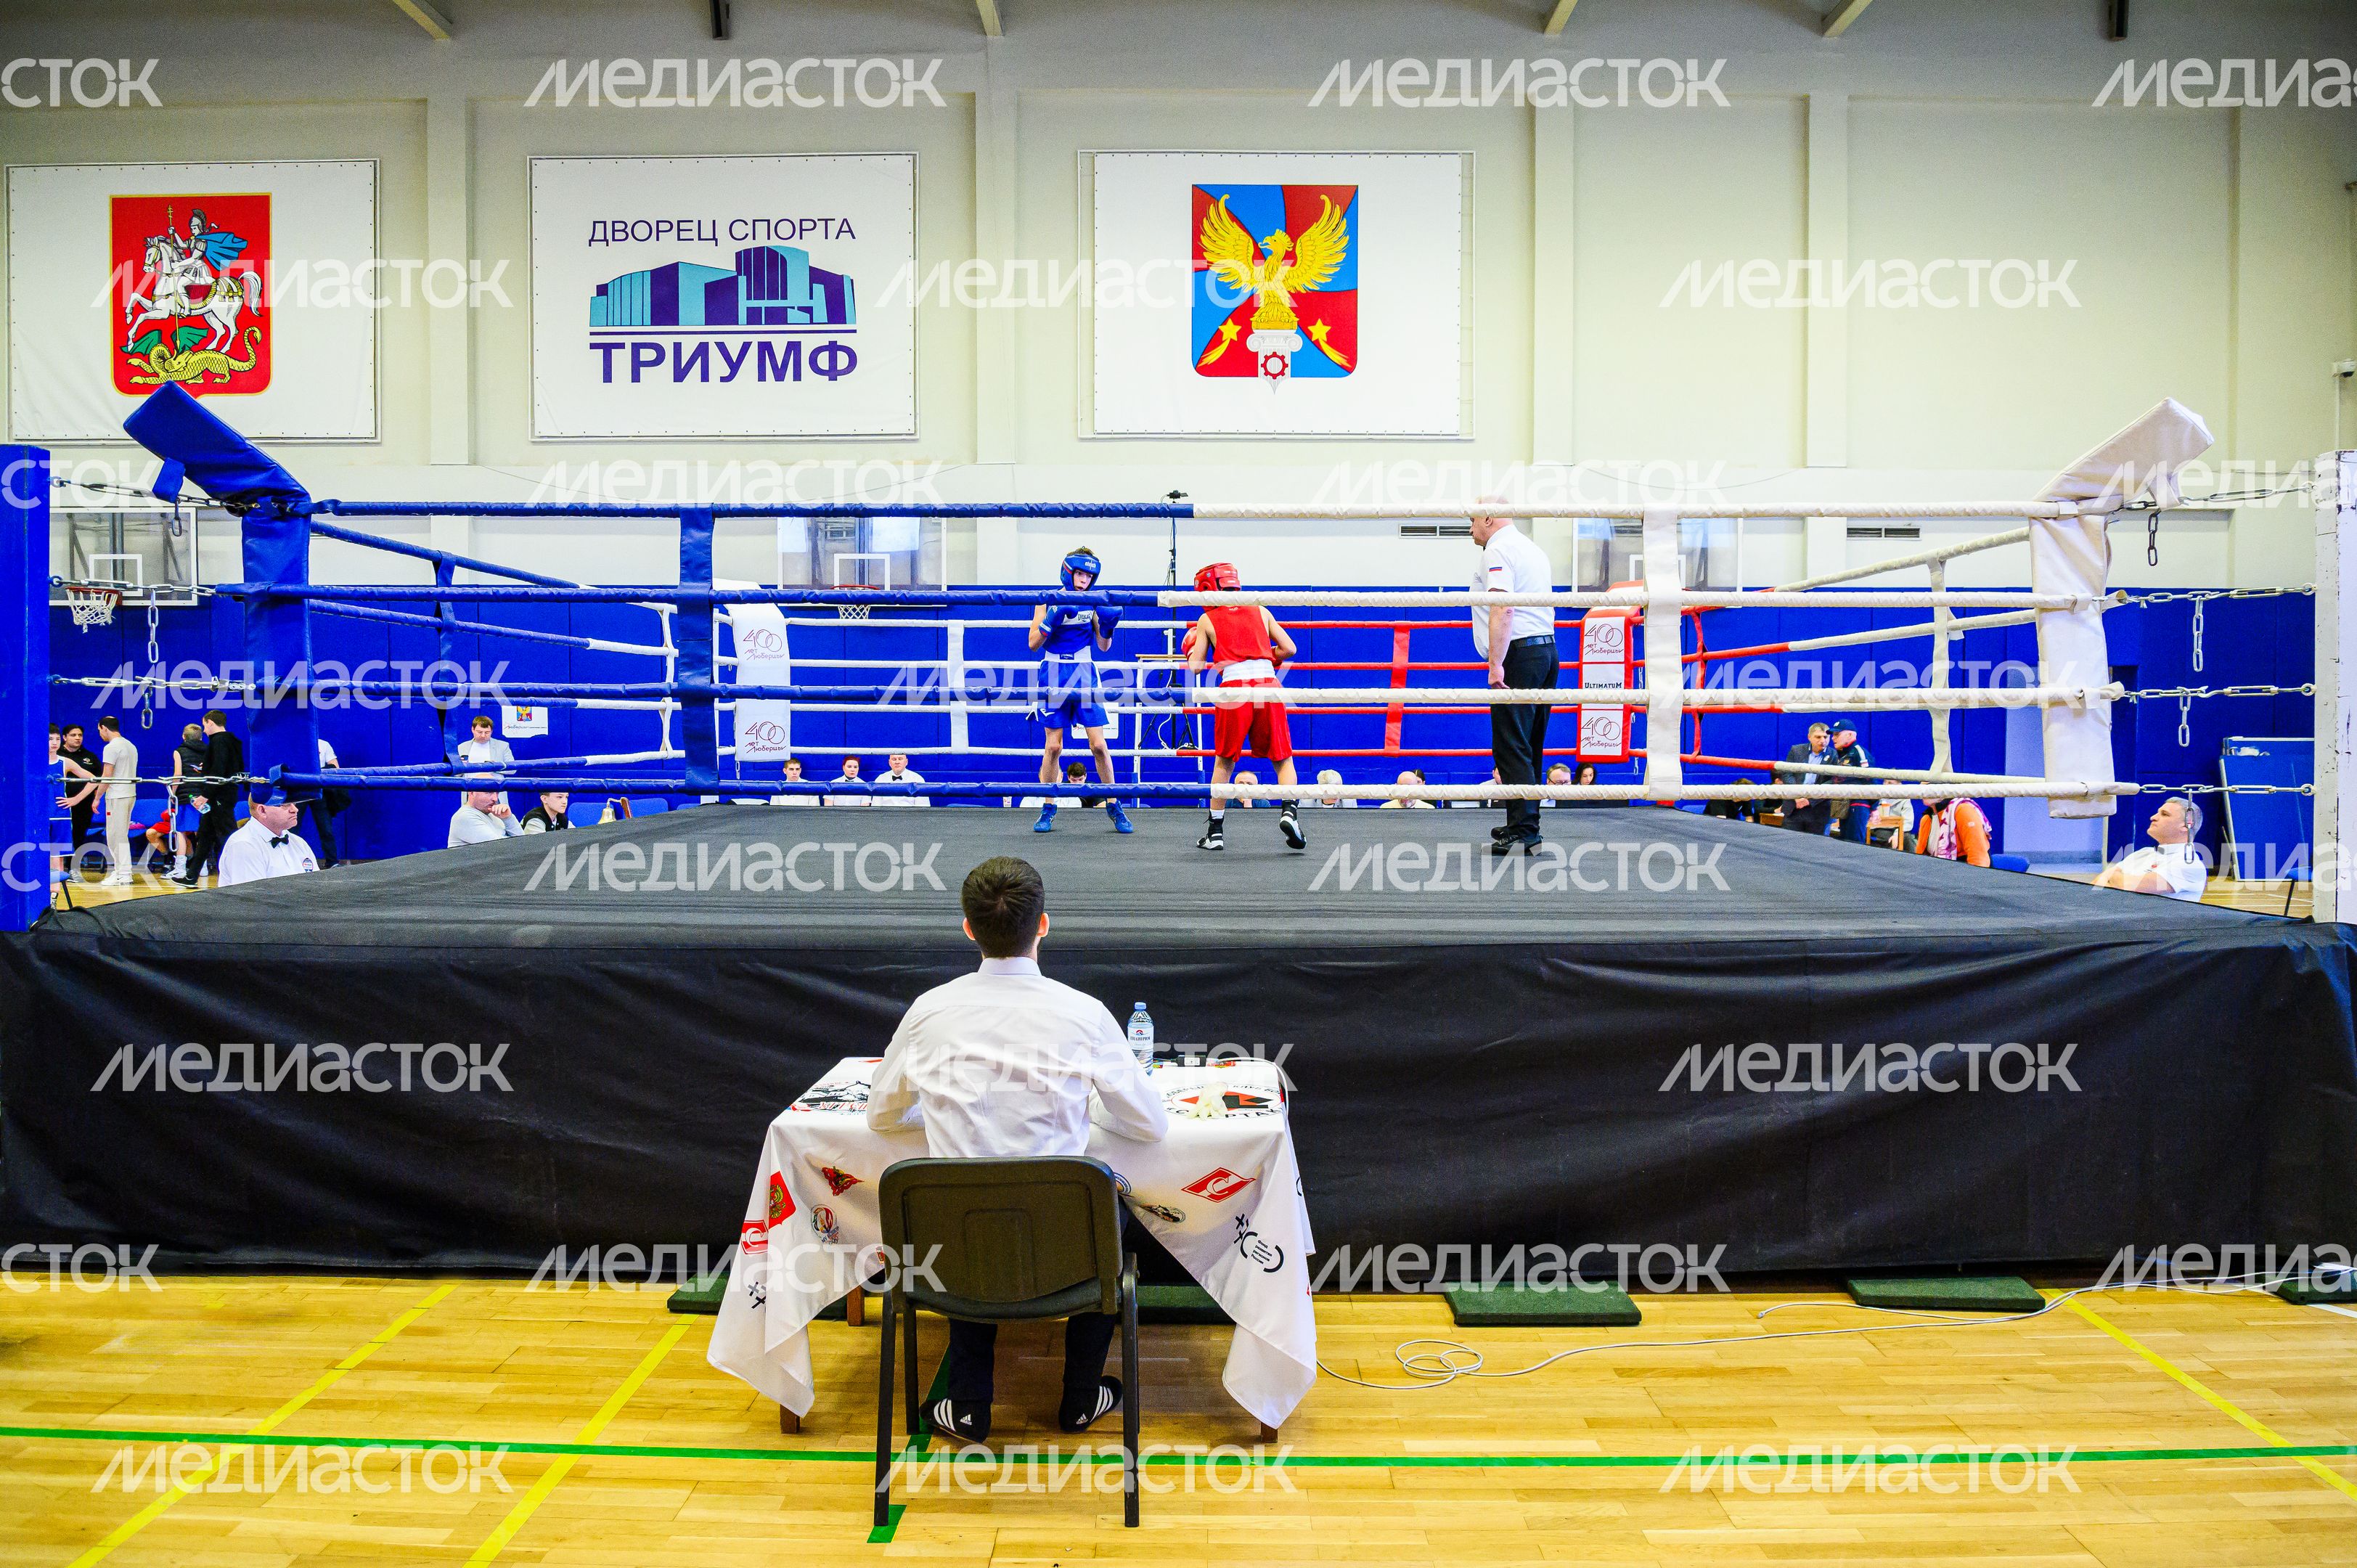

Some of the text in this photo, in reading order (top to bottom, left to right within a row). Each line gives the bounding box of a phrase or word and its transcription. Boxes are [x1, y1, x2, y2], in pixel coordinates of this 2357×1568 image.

[589, 218, 857, 247] ДВОРЕЦ СПОРТА
[589, 340, 858, 383] ТРИУМФ
[743, 629, 782, 652] 400
[1585, 624, 1623, 647] 400
[745, 722, 785, 744] 400
[1581, 716, 1620, 740] 400
